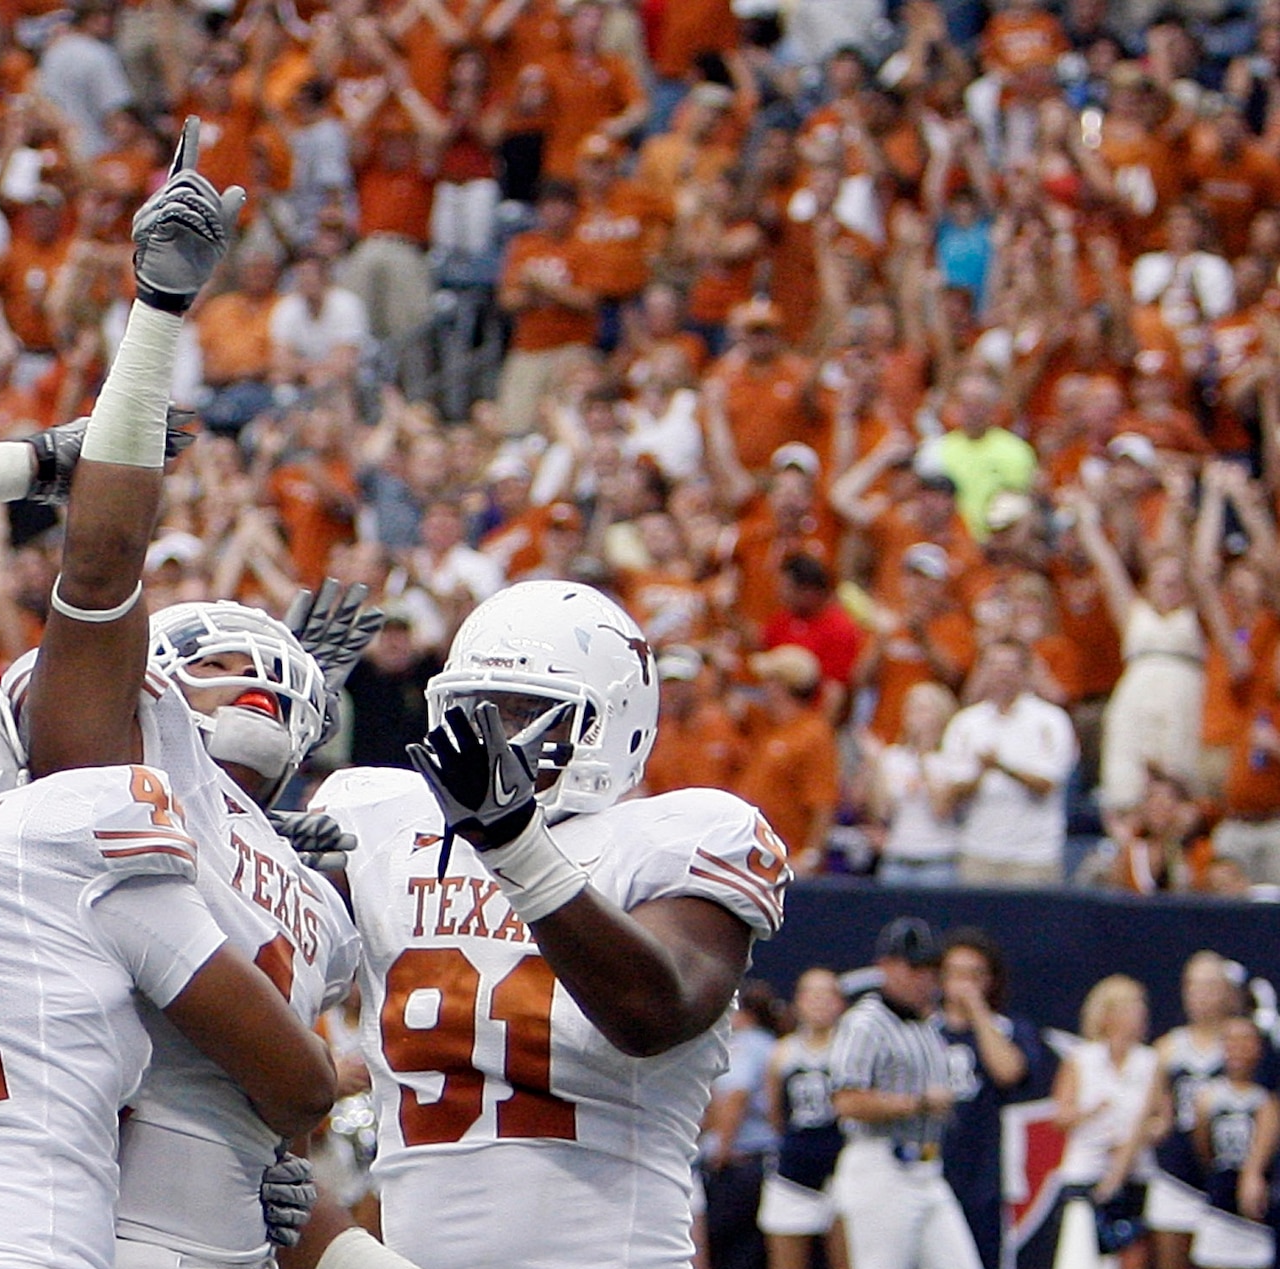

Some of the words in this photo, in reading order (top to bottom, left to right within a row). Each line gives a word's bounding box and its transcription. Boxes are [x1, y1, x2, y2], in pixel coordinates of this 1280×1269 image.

[230, 829, 321, 967] TEXAS
[408, 876, 538, 943] TEXA
[380, 947, 578, 1147] 91
